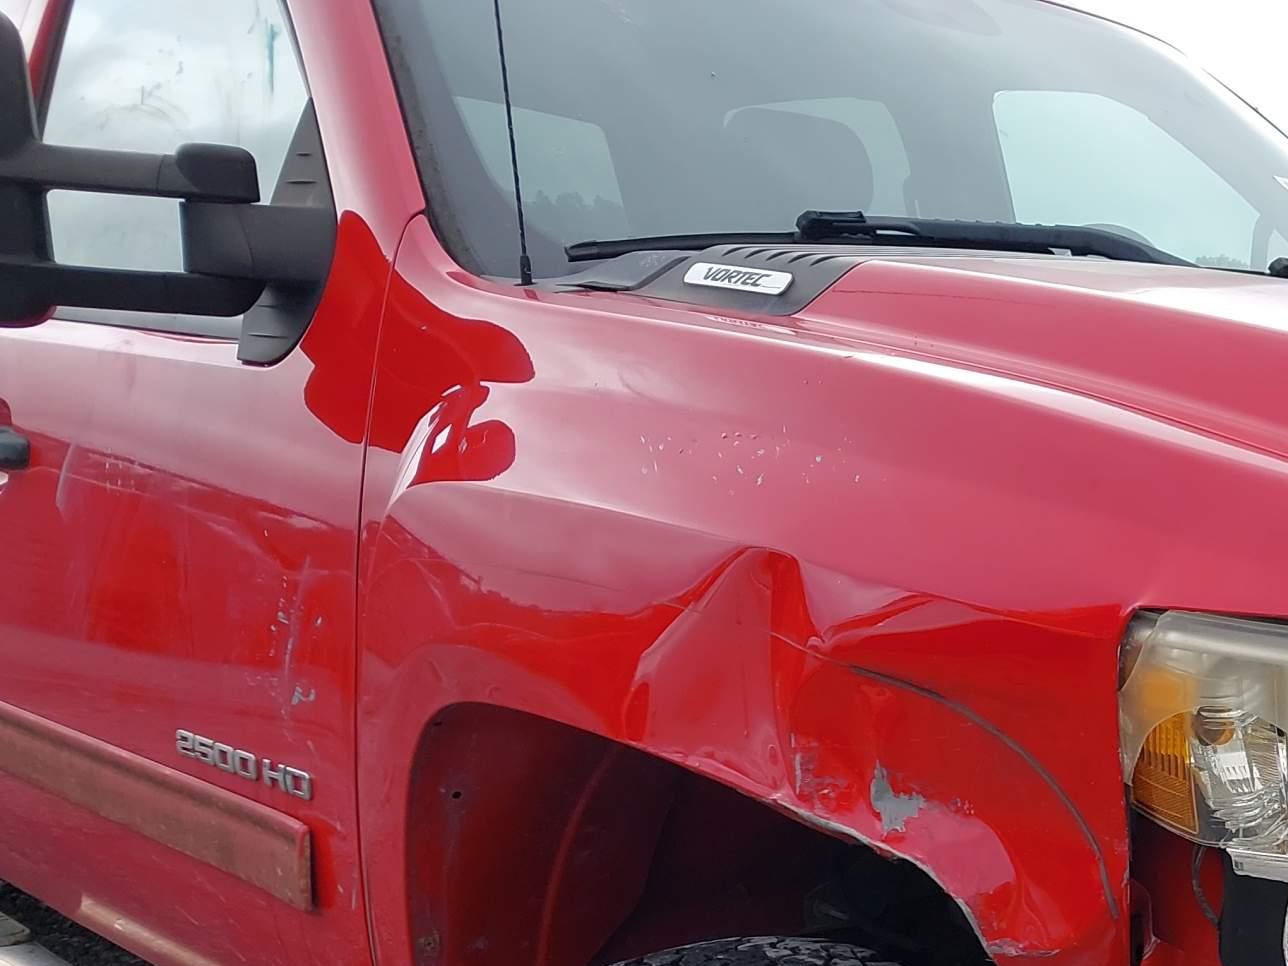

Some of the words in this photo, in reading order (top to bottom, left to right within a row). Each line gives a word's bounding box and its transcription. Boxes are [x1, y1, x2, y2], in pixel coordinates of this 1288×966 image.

[703, 266, 773, 287] VORTEC
[175, 729, 258, 780] 2500
[262, 758, 313, 801] HD
